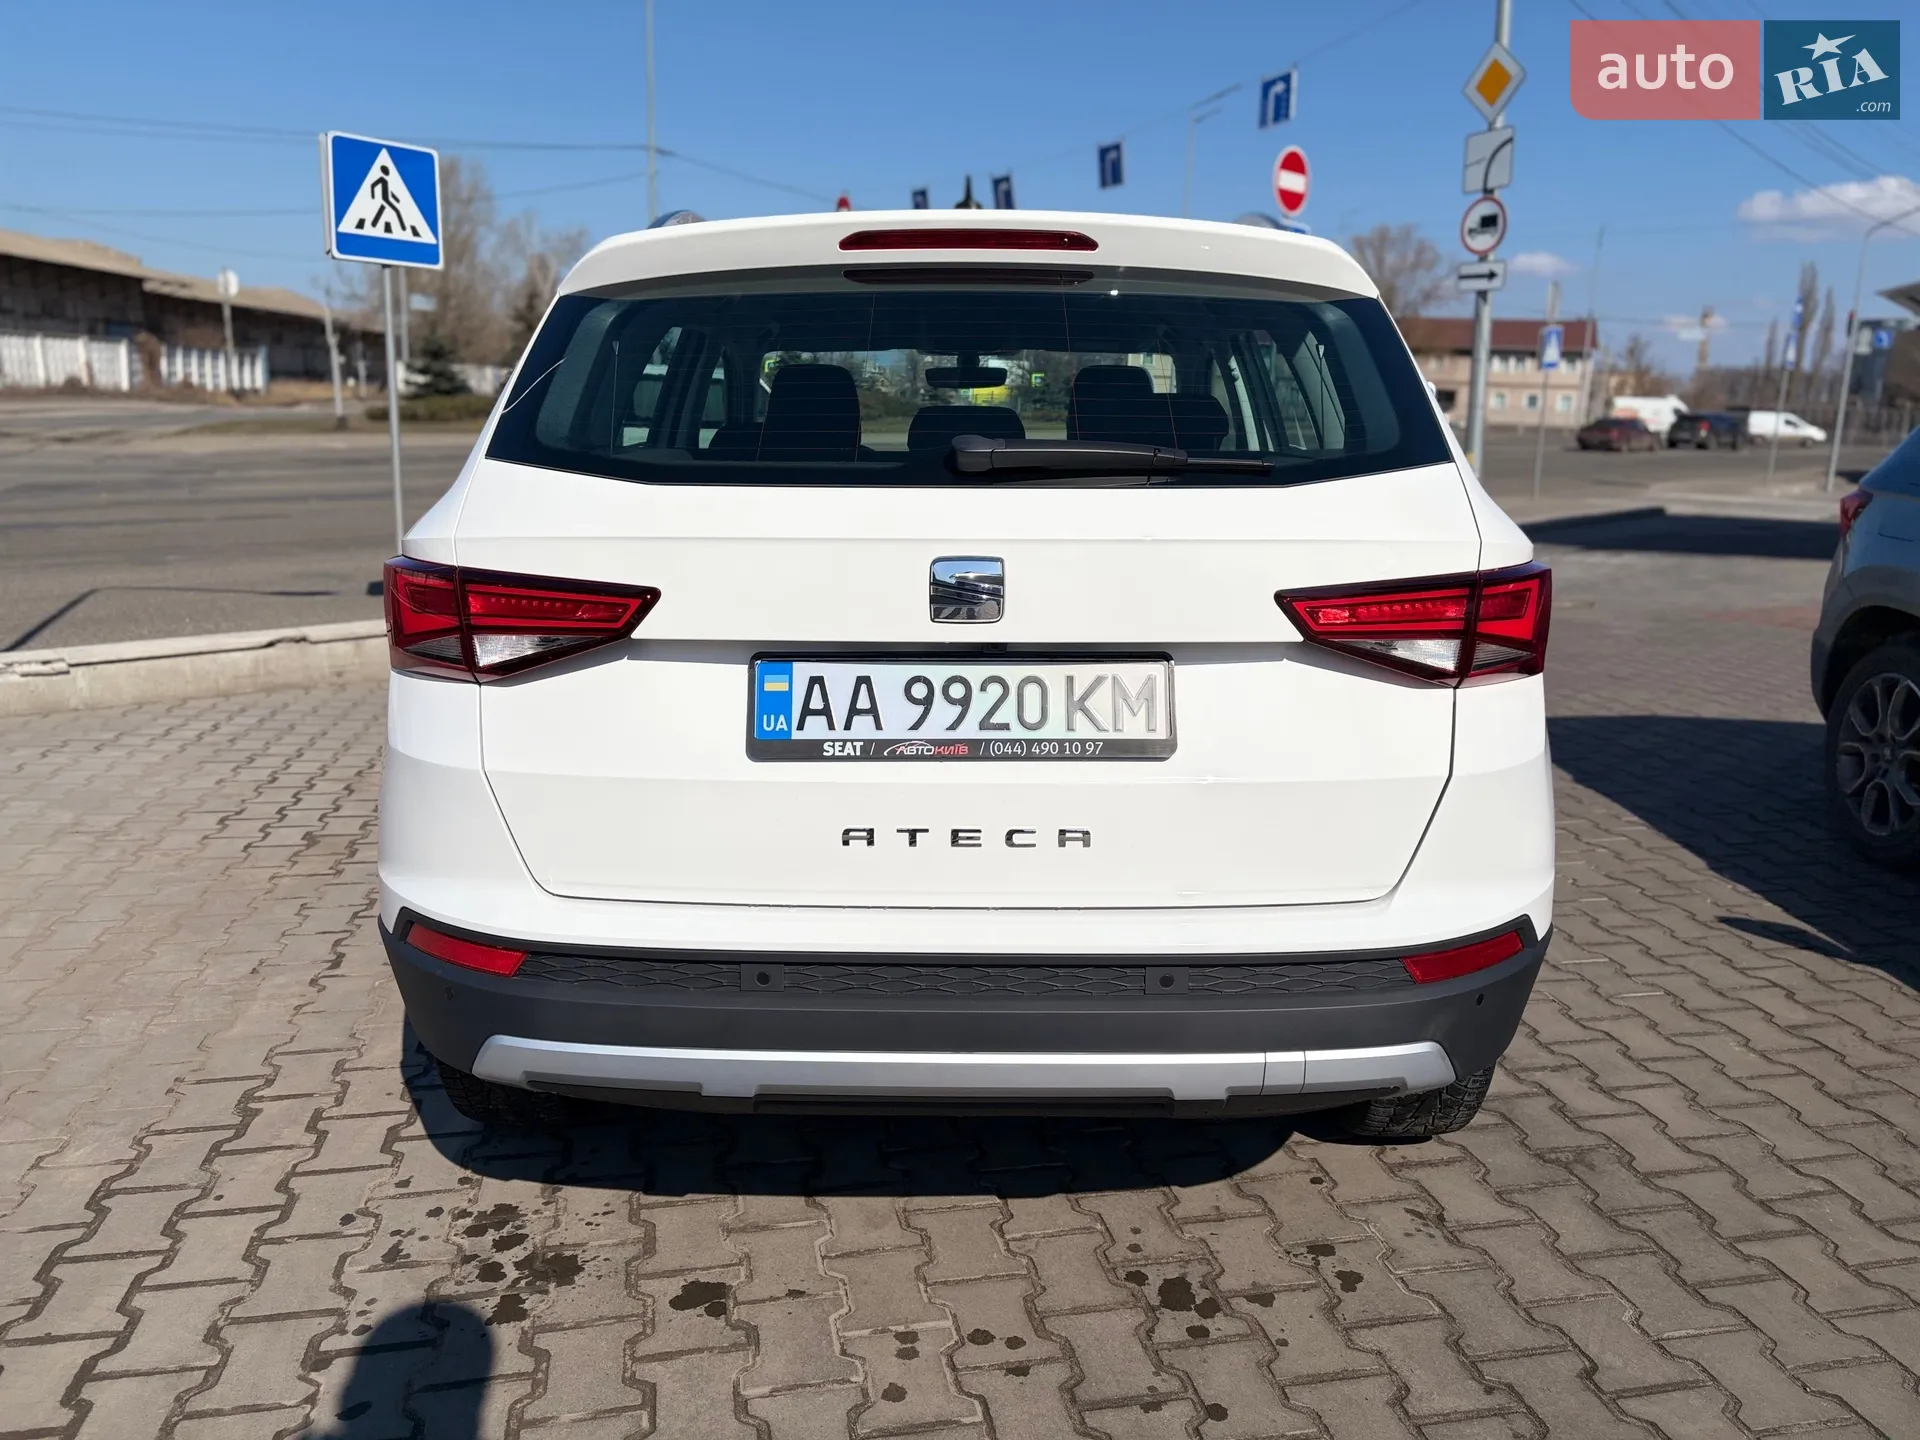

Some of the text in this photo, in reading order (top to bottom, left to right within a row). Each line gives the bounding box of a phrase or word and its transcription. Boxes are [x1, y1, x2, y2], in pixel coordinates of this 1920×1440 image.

[796, 674, 1157, 732] AA 9920 KM
[763, 714, 788, 731] UA
[822, 742, 864, 756] SEAT
[989, 741, 1027, 757] (044)
[1031, 742, 1060, 756] 490
[1064, 741, 1081, 755] 10
[1085, 741, 1103, 755] 97
[842, 828, 1091, 847] ATECA
